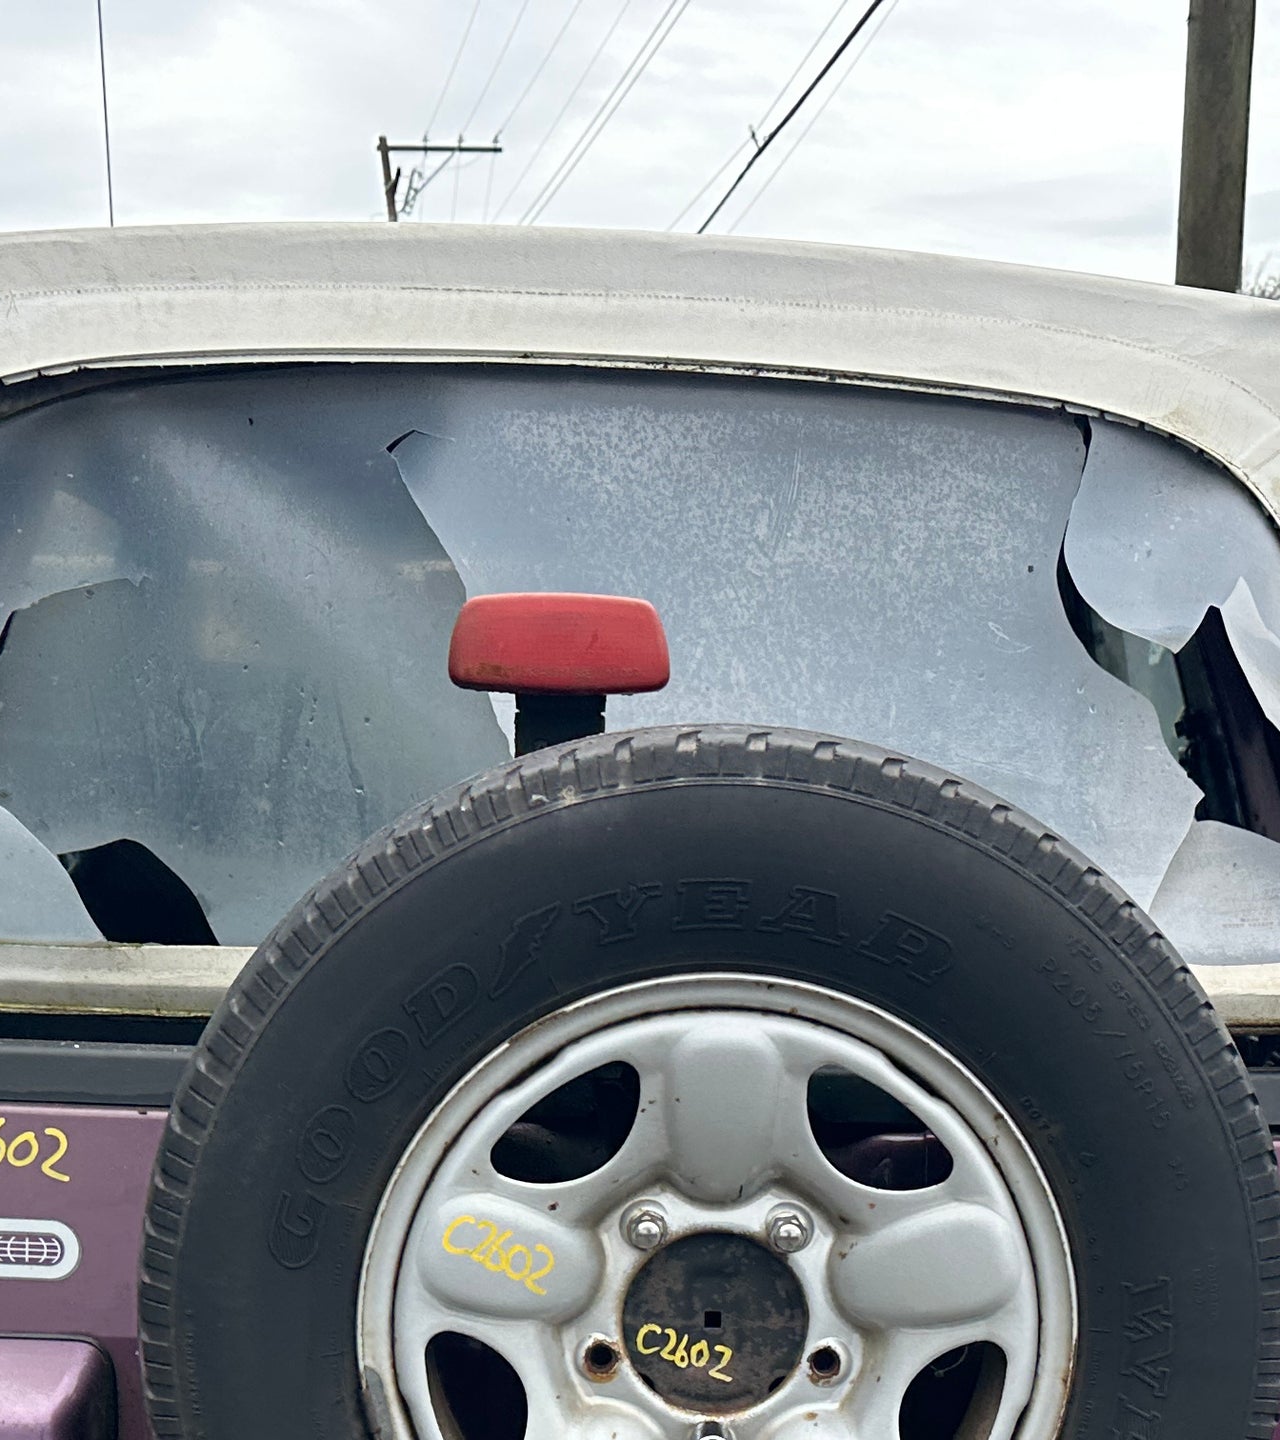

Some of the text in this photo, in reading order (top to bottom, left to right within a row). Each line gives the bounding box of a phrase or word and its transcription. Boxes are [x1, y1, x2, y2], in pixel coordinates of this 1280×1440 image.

[268, 876, 954, 1270] GOODYEAR
[441, 1215, 556, 1296] C2602
[636, 1323, 733, 1383] C2602
